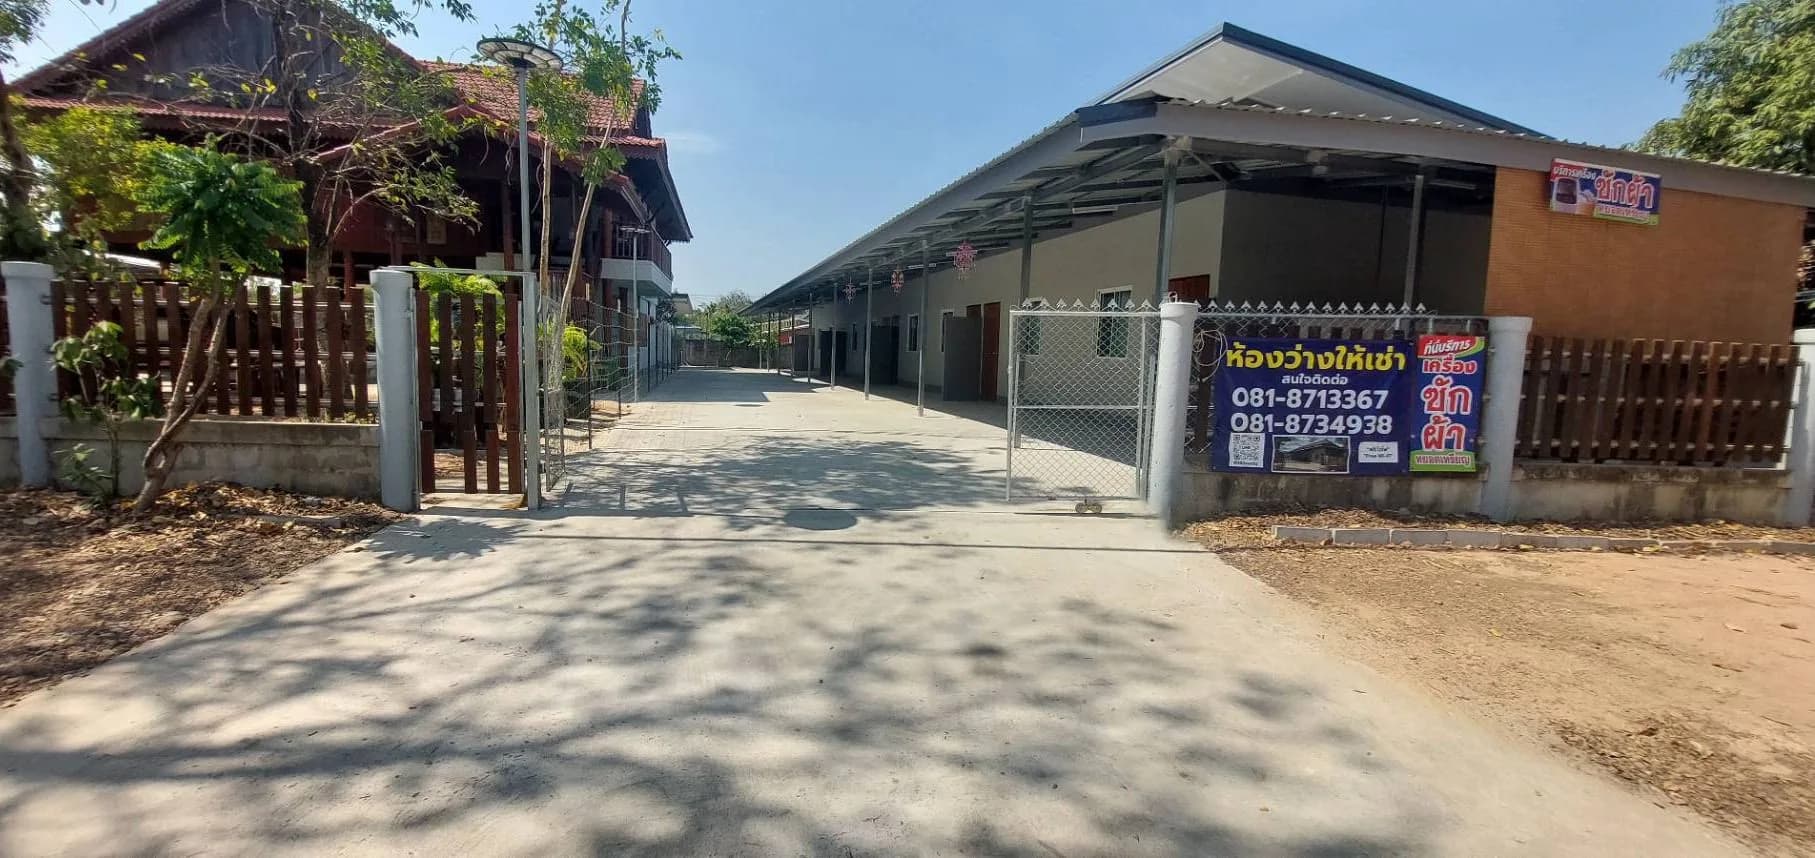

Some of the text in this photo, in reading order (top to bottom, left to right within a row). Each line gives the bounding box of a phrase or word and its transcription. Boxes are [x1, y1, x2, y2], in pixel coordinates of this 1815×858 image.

[1226, 341, 1407, 371] ห้องว่างให้เช่า
[1422, 354, 1477, 374] เครื่อง
[1281, 371, 1348, 386] สนใจติดต่อ
[1231, 387, 1389, 410] 081-8713367
[1421, 375, 1472, 415] ซัก
[1230, 412, 1393, 435] 081-8734938
[1421, 414, 1467, 451] ผ้า
